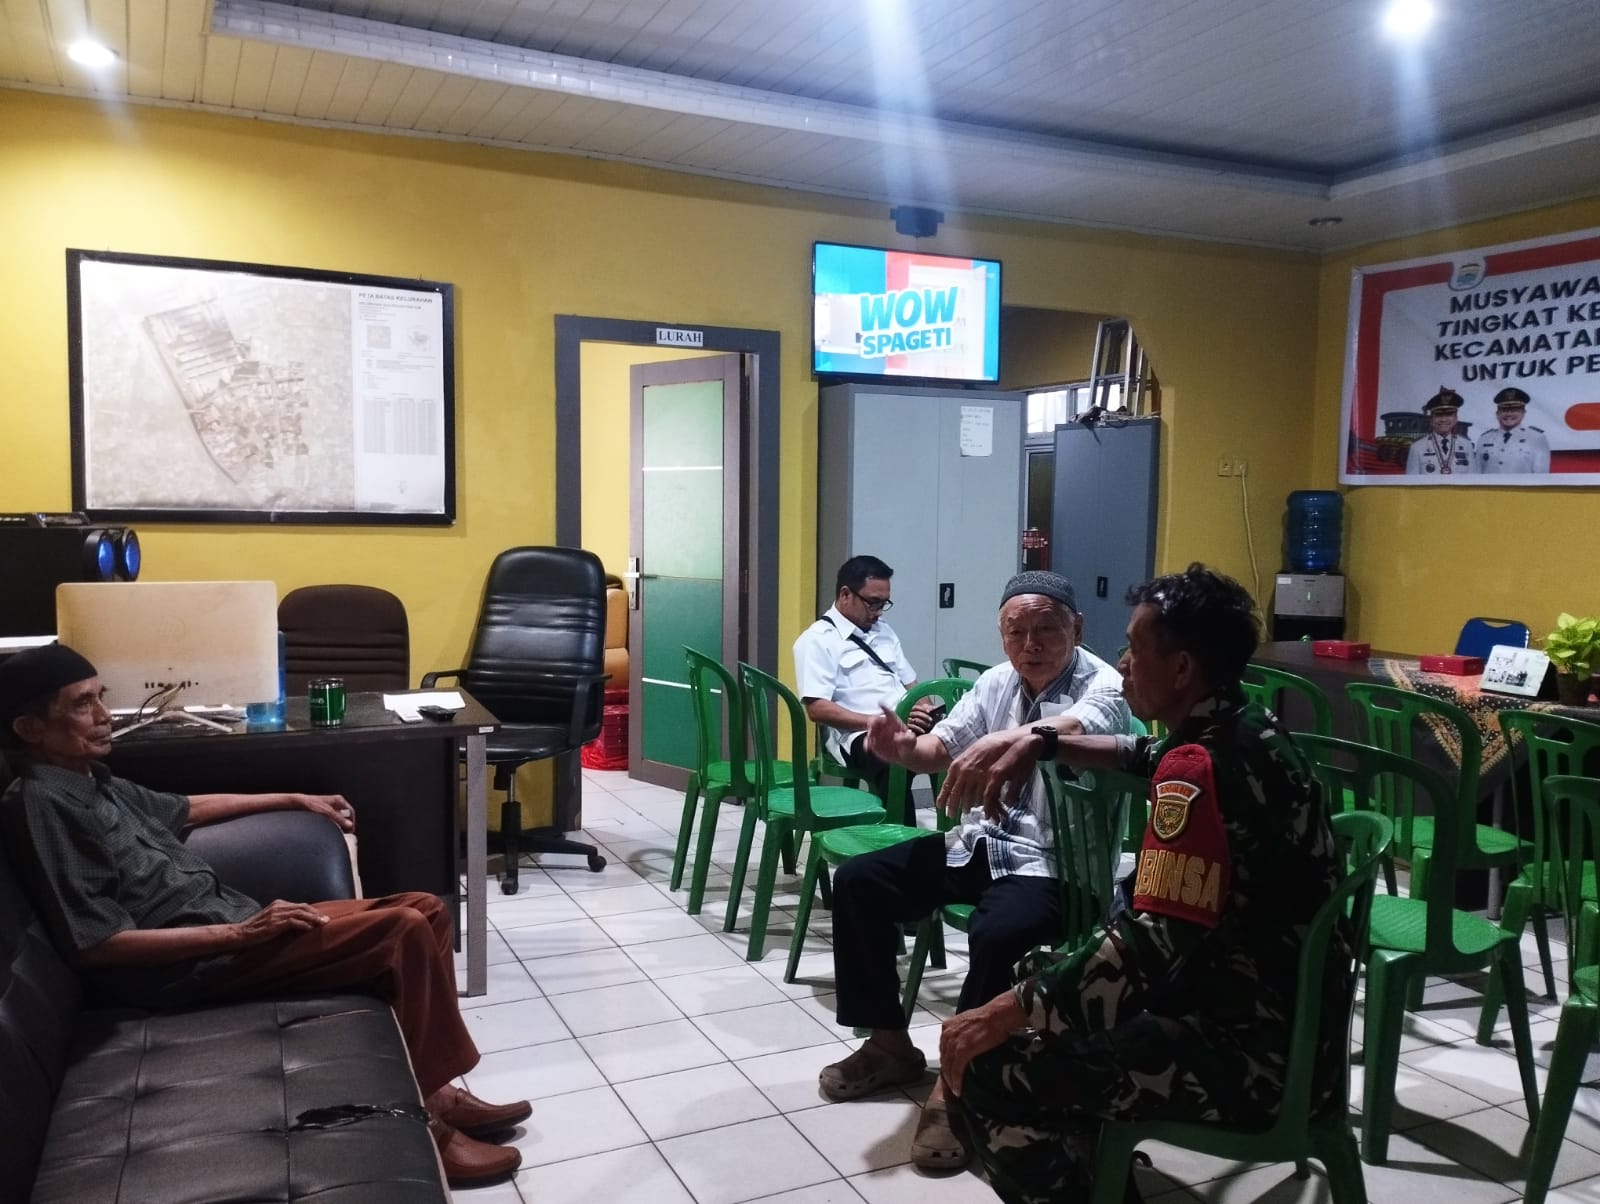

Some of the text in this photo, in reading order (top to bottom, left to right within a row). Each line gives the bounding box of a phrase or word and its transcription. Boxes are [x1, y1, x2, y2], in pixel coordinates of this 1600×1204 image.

[860, 286, 958, 332] WOW
[1450, 275, 1600, 314] MUSYAWA
[659, 330, 702, 343] LURAH
[1437, 306, 1559, 337] TINGKAT
[862, 327, 951, 356] SPAGETI
[1462, 357, 1557, 382] UNTUK
[1133, 849, 1221, 912] BINSA
